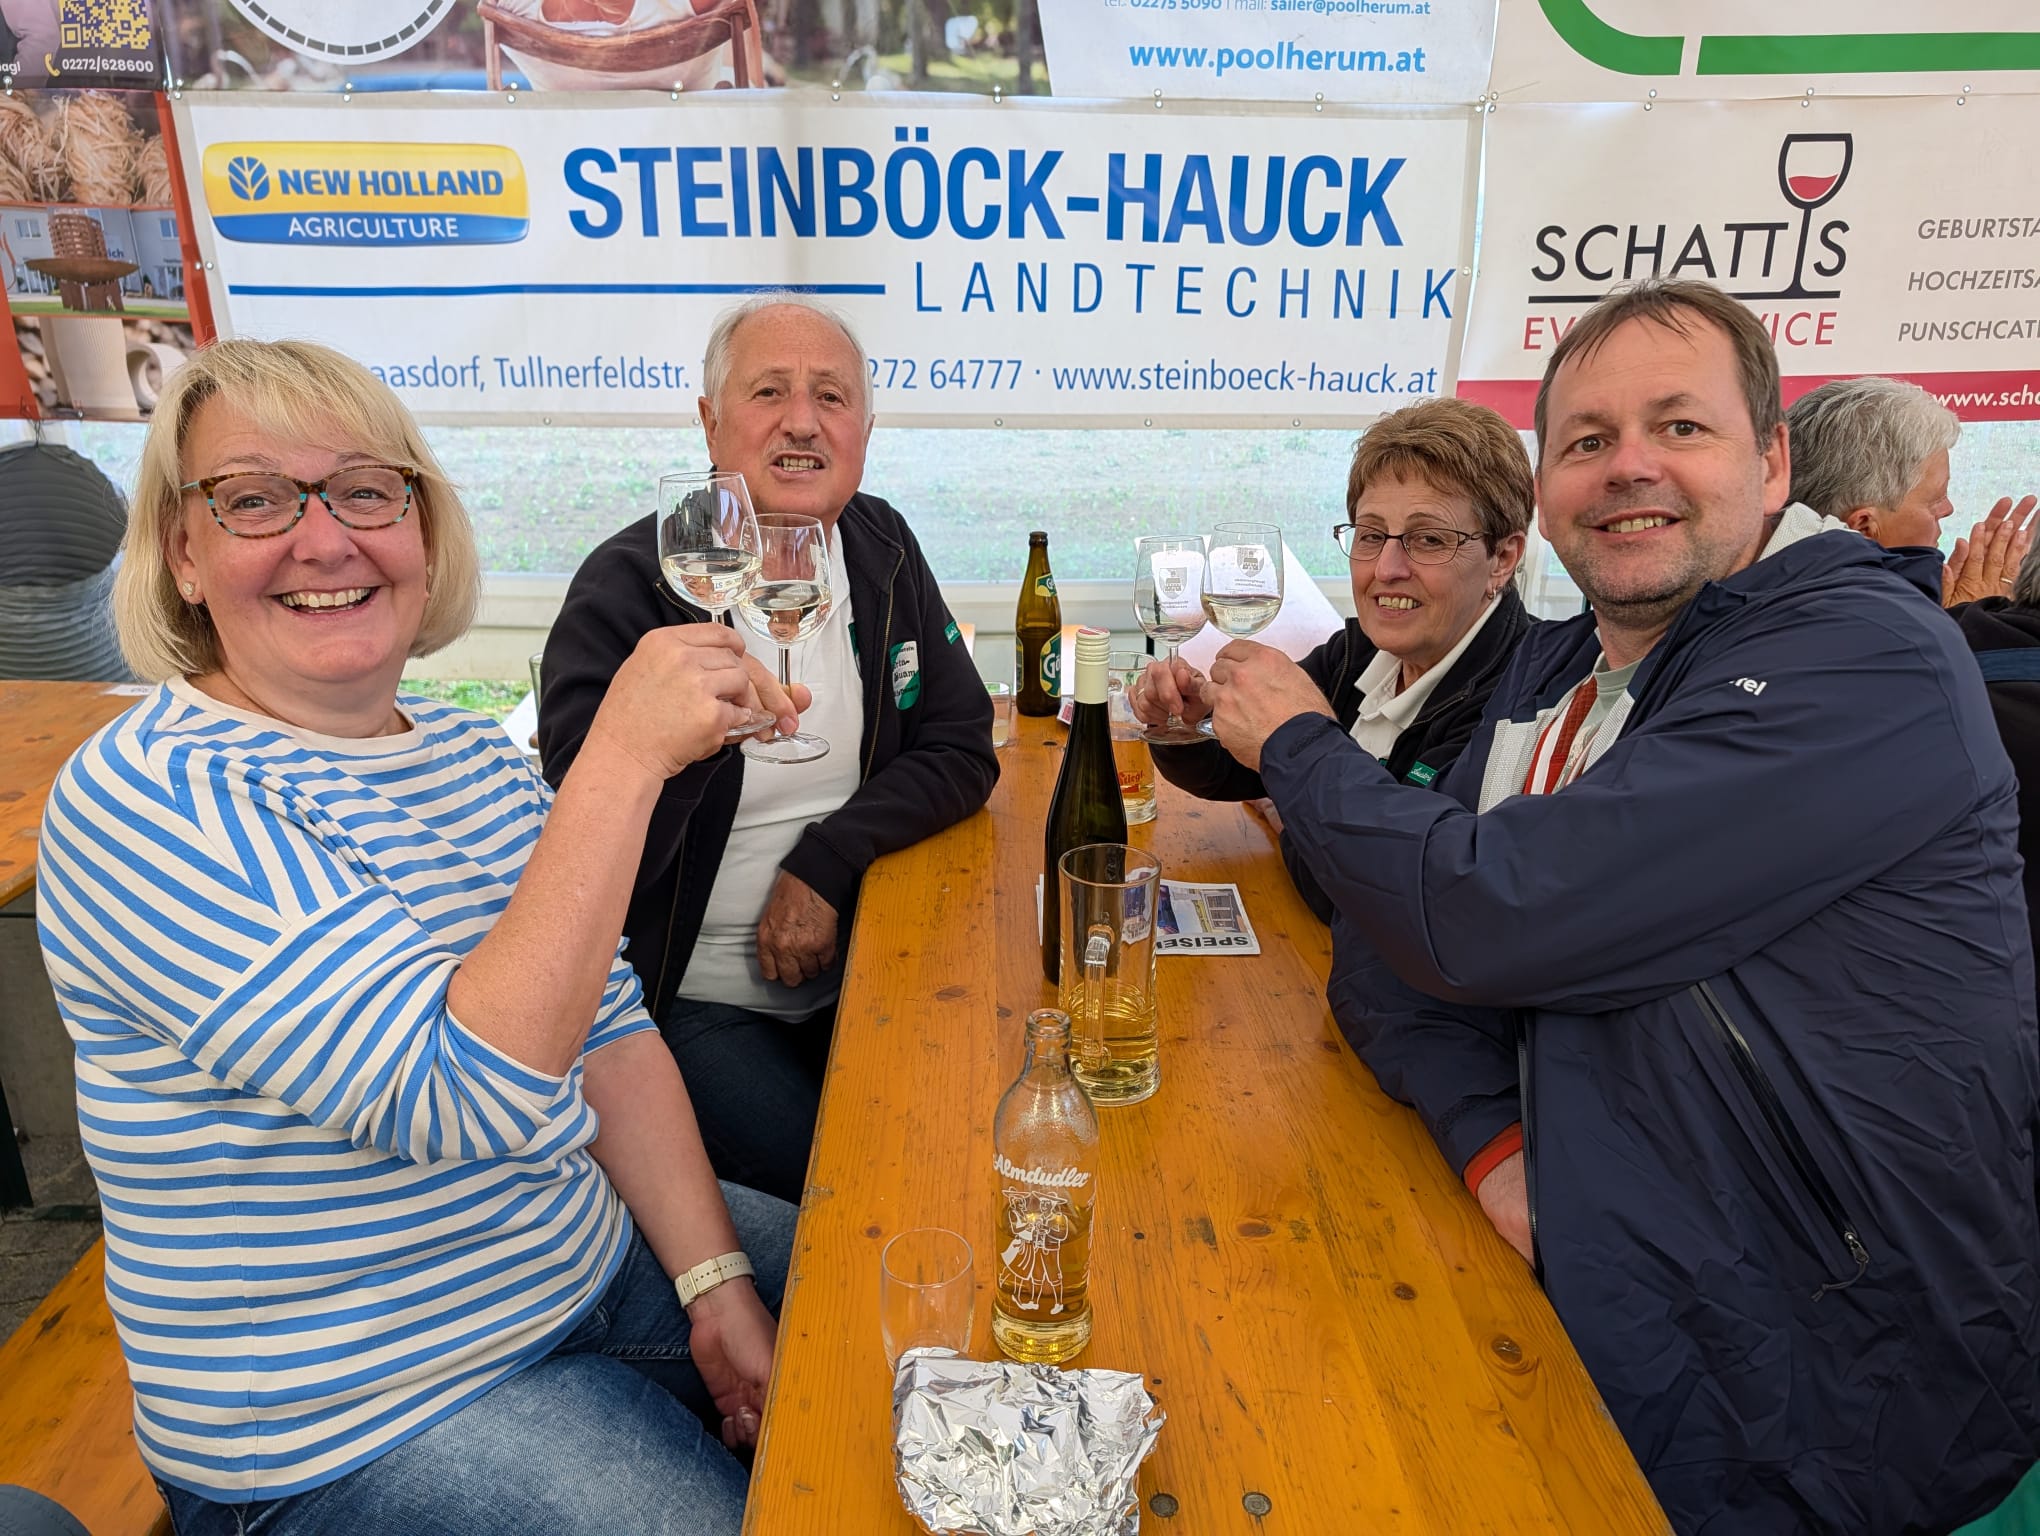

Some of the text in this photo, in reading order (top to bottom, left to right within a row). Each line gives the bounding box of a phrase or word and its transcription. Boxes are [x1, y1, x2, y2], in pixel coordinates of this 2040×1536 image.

[62, 56, 154, 73] 02272/628600
[1128, 41, 1426, 78] www.poolherum.at
[280, 170, 503, 196] NEW HOLLAND
[563, 126, 1406, 248] STEINBÖCK-HAUCK
[288, 217, 459, 238] AGRICULTURE
[916, 261, 1456, 319] LANDTECHNIK
[494, 356, 689, 389] Tullnerfeldstr.
[929, 358, 1022, 390] 64777
[1053, 360, 1437, 394] www.steinboeck-hauck.at
